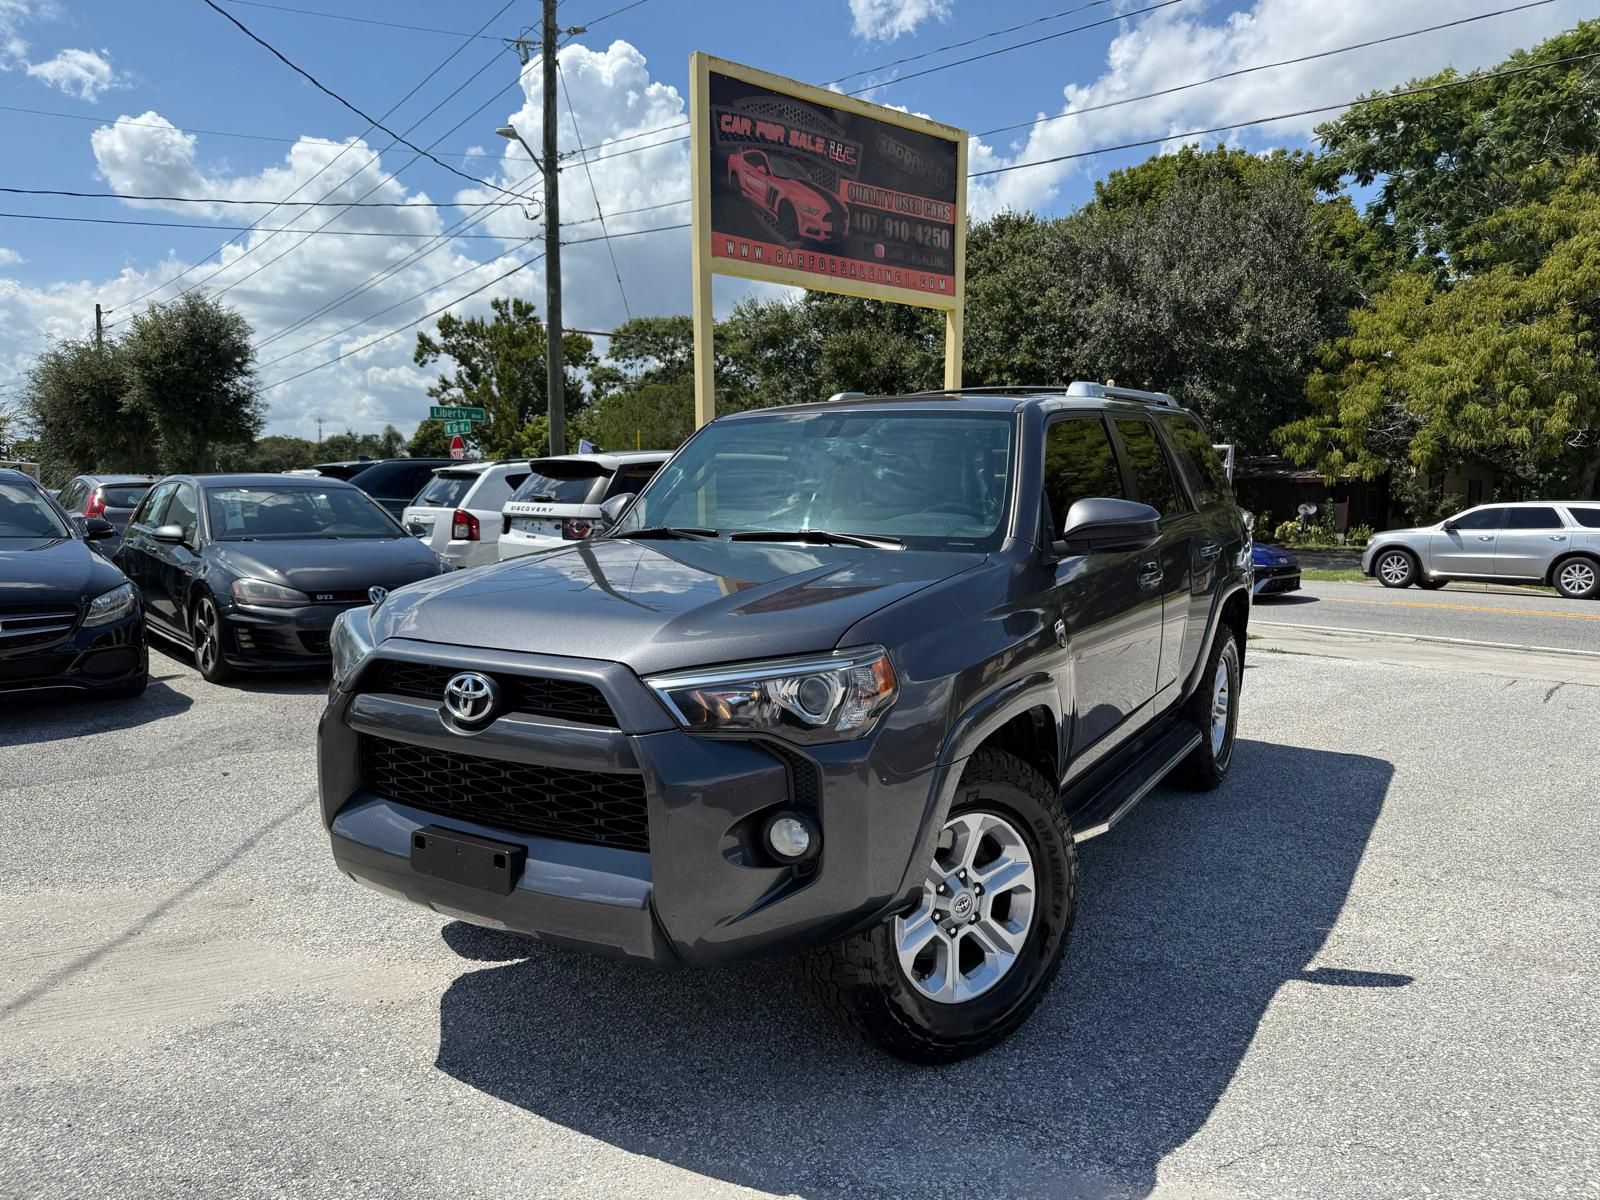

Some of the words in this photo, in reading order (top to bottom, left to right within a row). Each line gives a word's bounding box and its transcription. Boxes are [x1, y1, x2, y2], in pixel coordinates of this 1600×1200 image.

[720, 113, 752, 137] CAR
[755, 120, 785, 143] FOR
[848, 182, 894, 210] QUALITY
[895, 191, 922, 215] USED
[925, 200, 951, 221] CARS
[434, 408, 467, 419] Liberty
[510, 505, 554, 513] DISCOVERY
